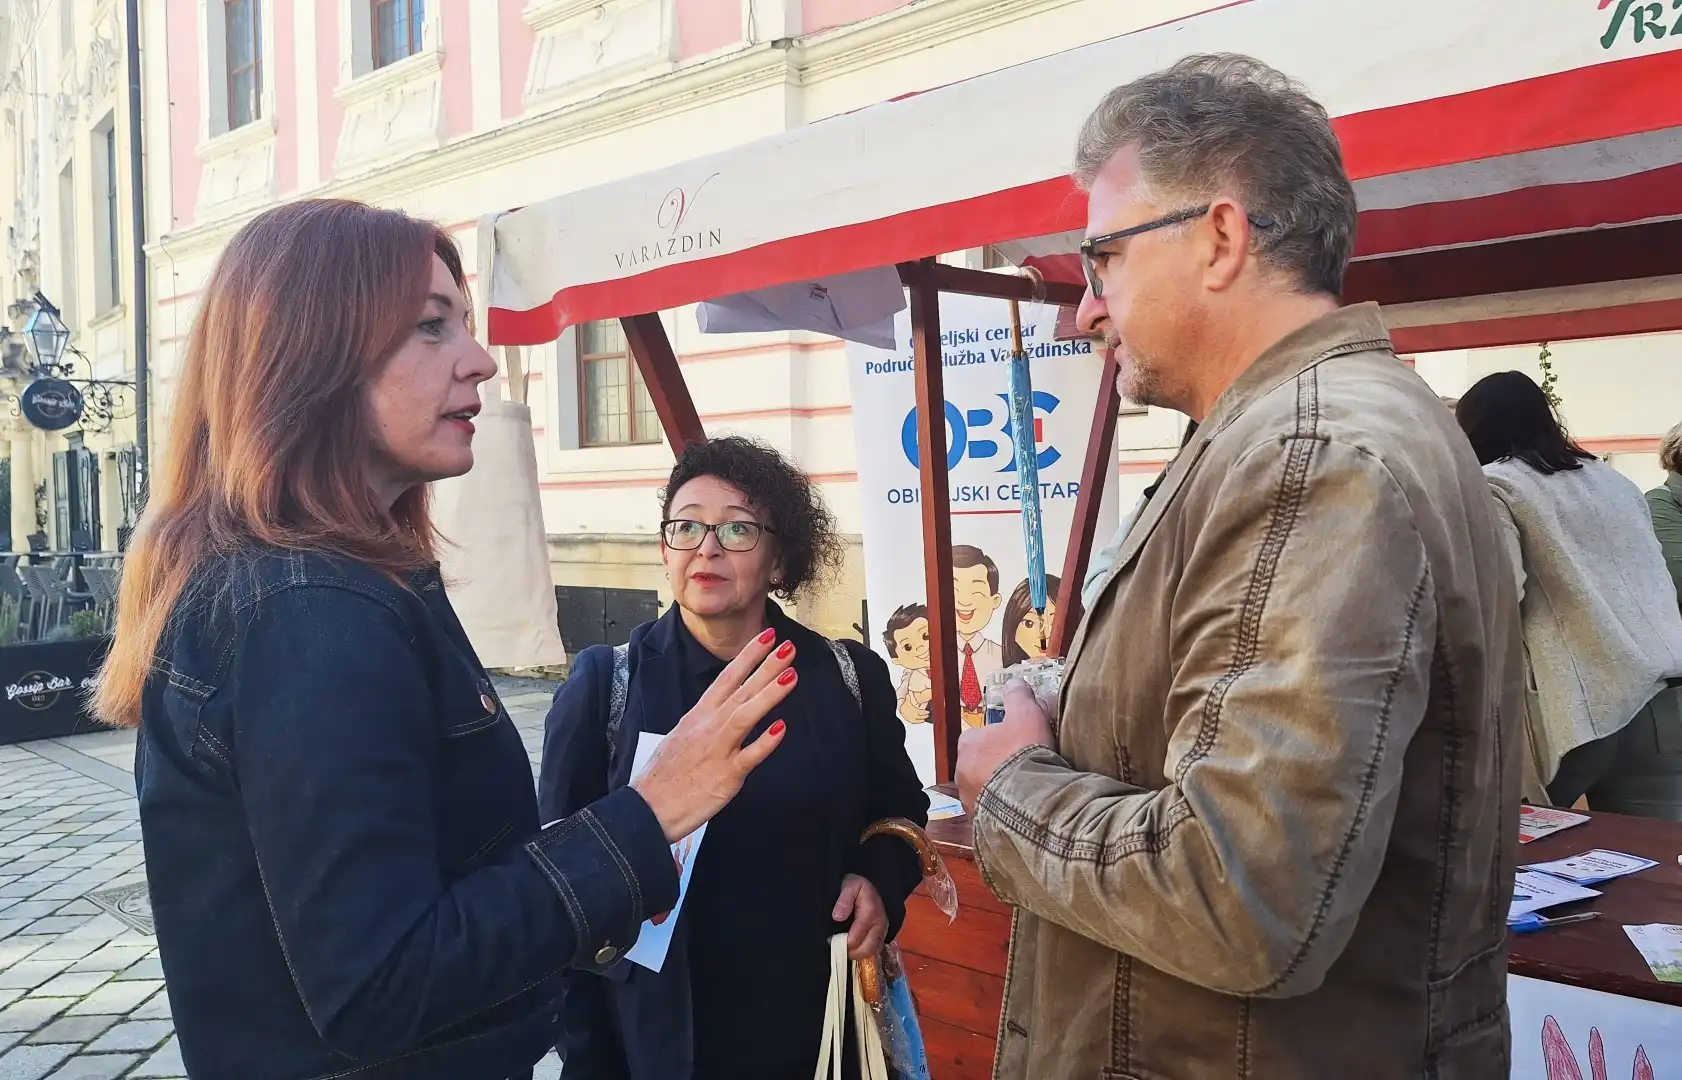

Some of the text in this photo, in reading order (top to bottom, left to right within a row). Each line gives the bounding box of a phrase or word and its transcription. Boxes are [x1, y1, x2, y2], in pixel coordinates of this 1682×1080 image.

[985, 324, 1037, 341] cenar
[887, 482, 1080, 504] OBIJSKI CETAR
